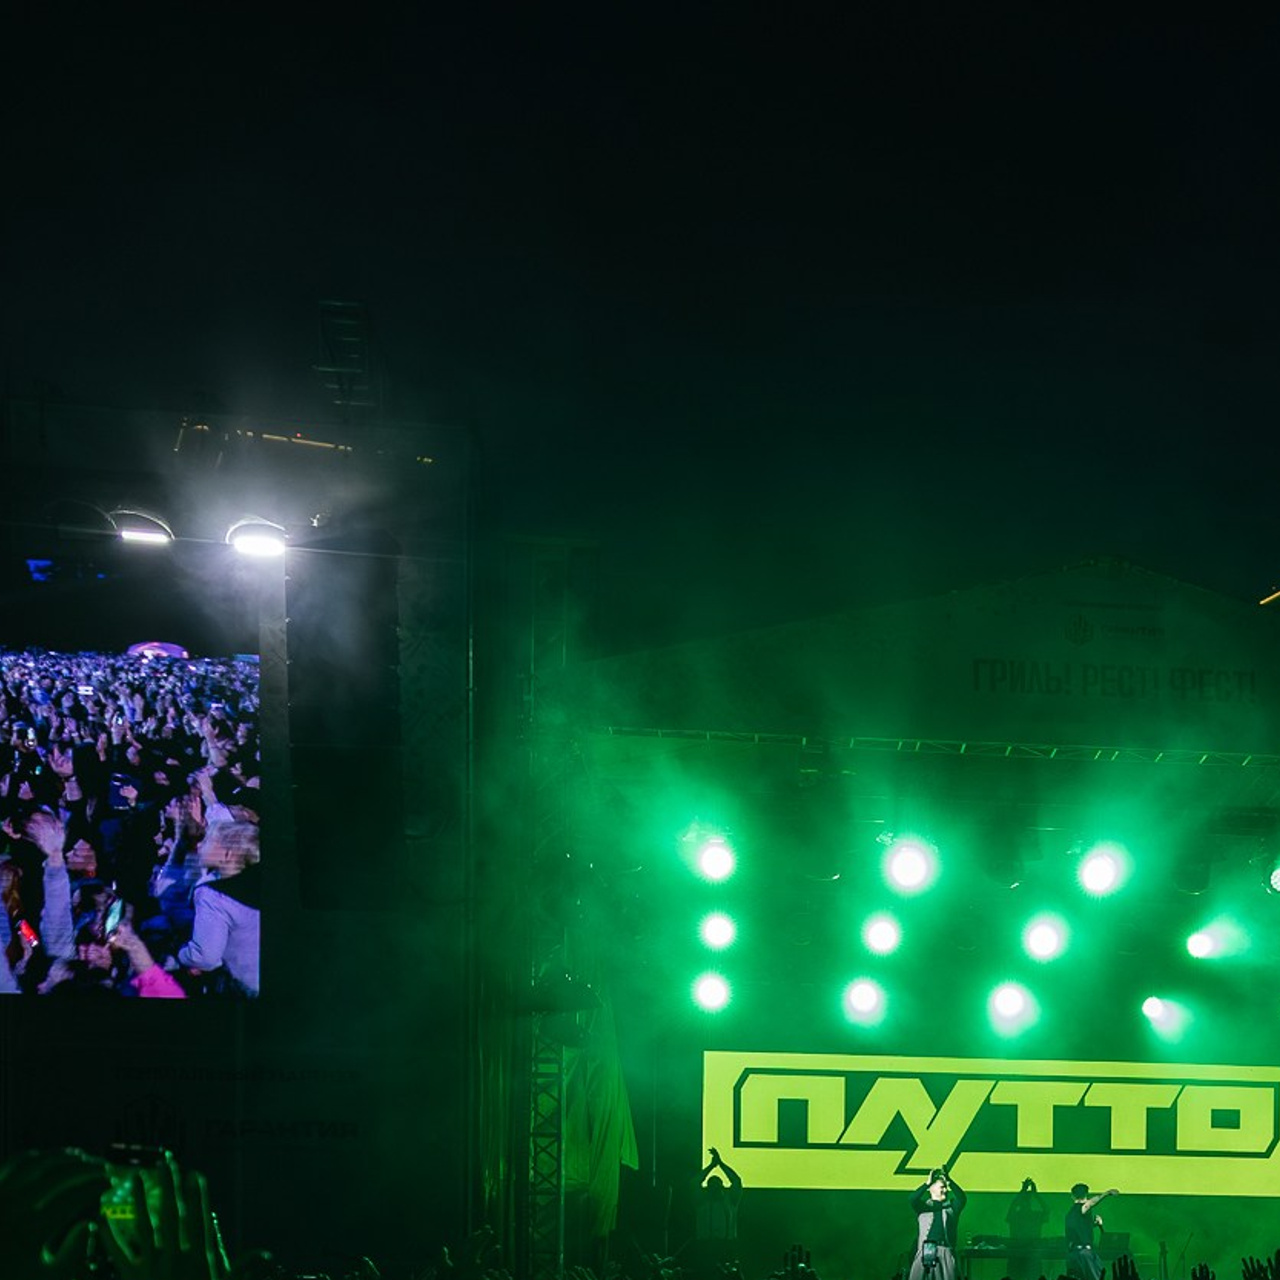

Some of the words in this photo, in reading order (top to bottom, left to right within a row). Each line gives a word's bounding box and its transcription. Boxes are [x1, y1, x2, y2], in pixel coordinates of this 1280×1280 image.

[972, 658, 1072, 696] ГРИЛЬ!
[1081, 662, 1159, 699] РЕСТ!
[1169, 666, 1257, 701] ФЕСТ!
